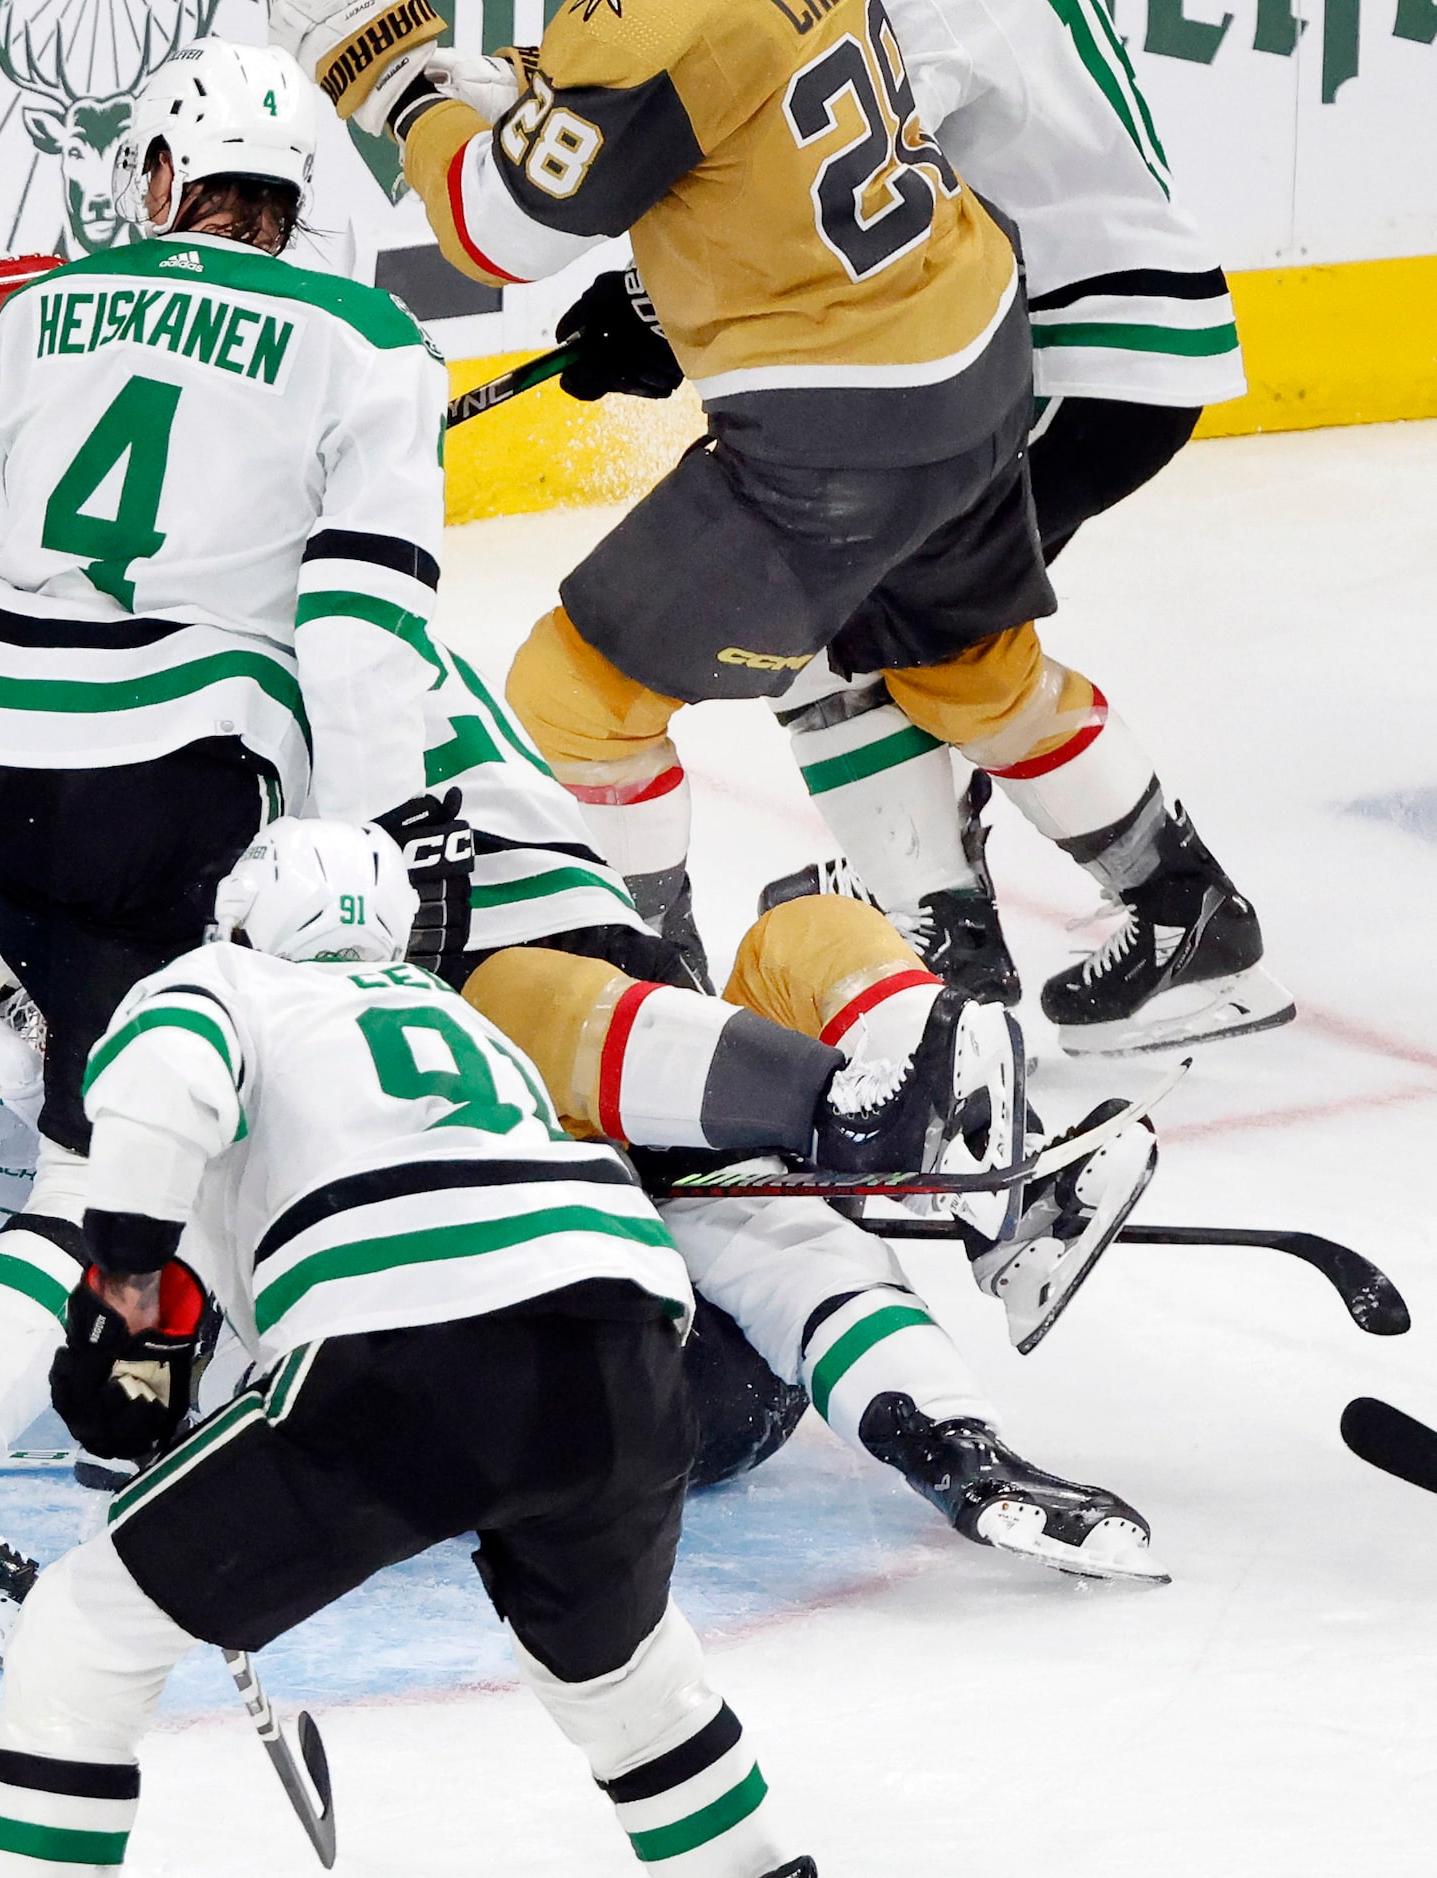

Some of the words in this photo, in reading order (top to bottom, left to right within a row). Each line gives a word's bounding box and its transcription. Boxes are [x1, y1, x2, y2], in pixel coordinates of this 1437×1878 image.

[263, 89, 277, 116] 4
[500, 71, 604, 199] 28
[781, 0, 962, 284] 28
[158, 260, 204, 273] adidas
[37, 289, 294, 386] HEISKANEN
[41, 374, 183, 614] 4
[717, 647, 815, 671] CCM
[340, 894, 366, 925] 91
